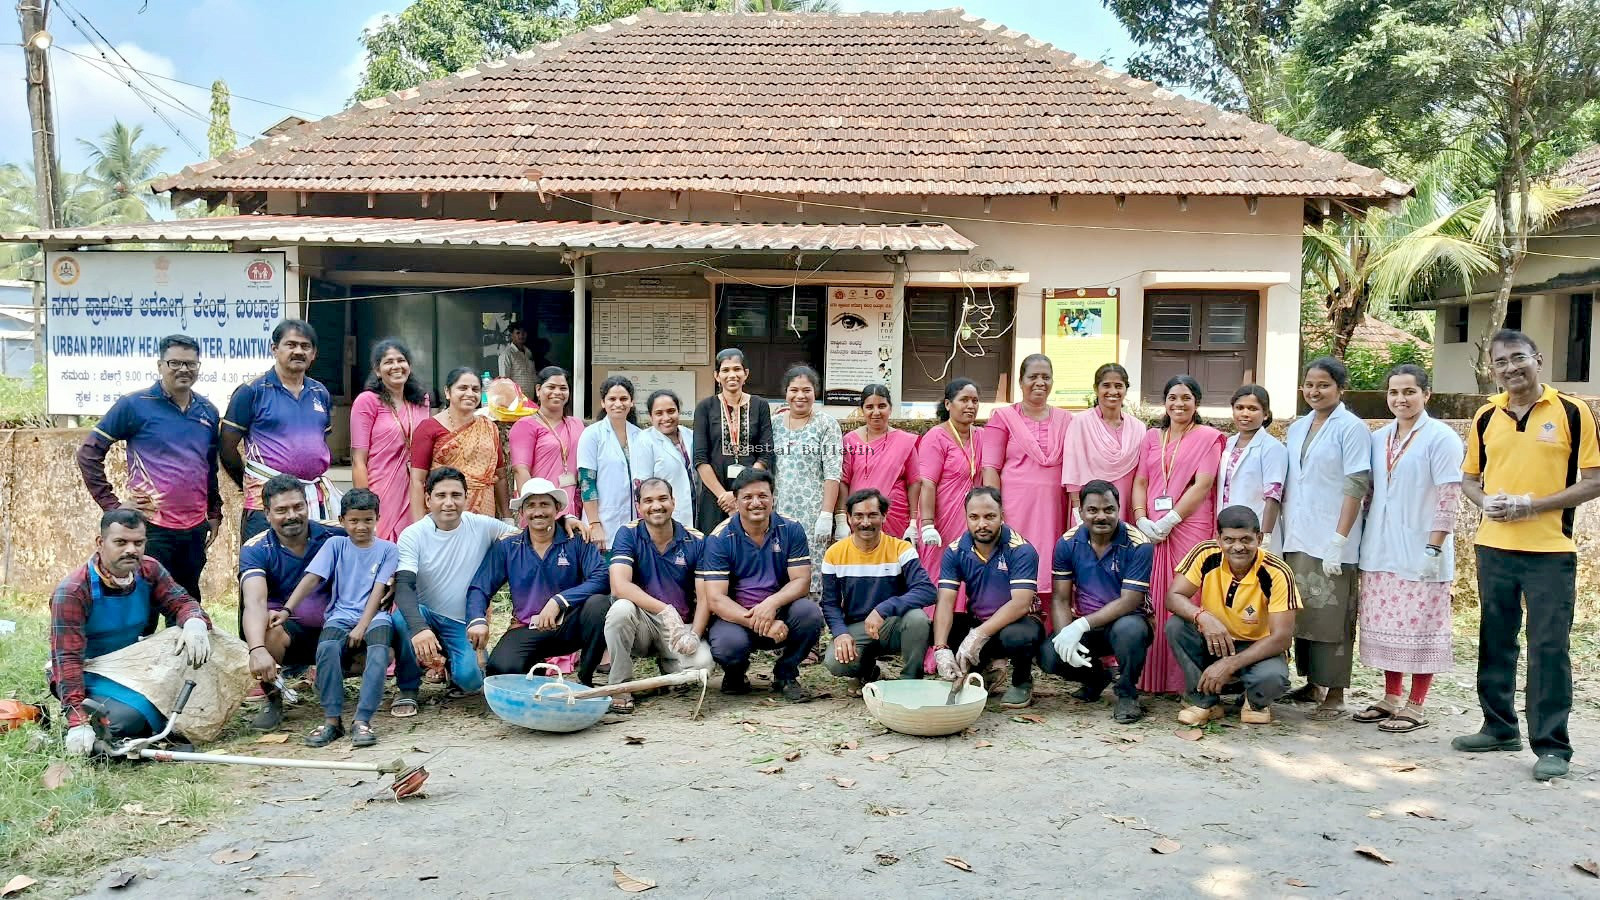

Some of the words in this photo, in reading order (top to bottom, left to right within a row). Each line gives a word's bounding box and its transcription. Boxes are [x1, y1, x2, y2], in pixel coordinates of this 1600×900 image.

[52, 290, 80, 317] ನಗರ
[85, 290, 134, 326] ಪ್ರಾಥಮಿಕ
[140, 290, 187, 331] ಆರೋಗ್ಯ
[52, 336, 87, 357] URBAN
[90, 336, 135, 357] PRIMARY
[229, 337, 274, 359] BANTWA
[125, 371, 142, 382] 9.00
[221, 372, 239, 383] 4.30
